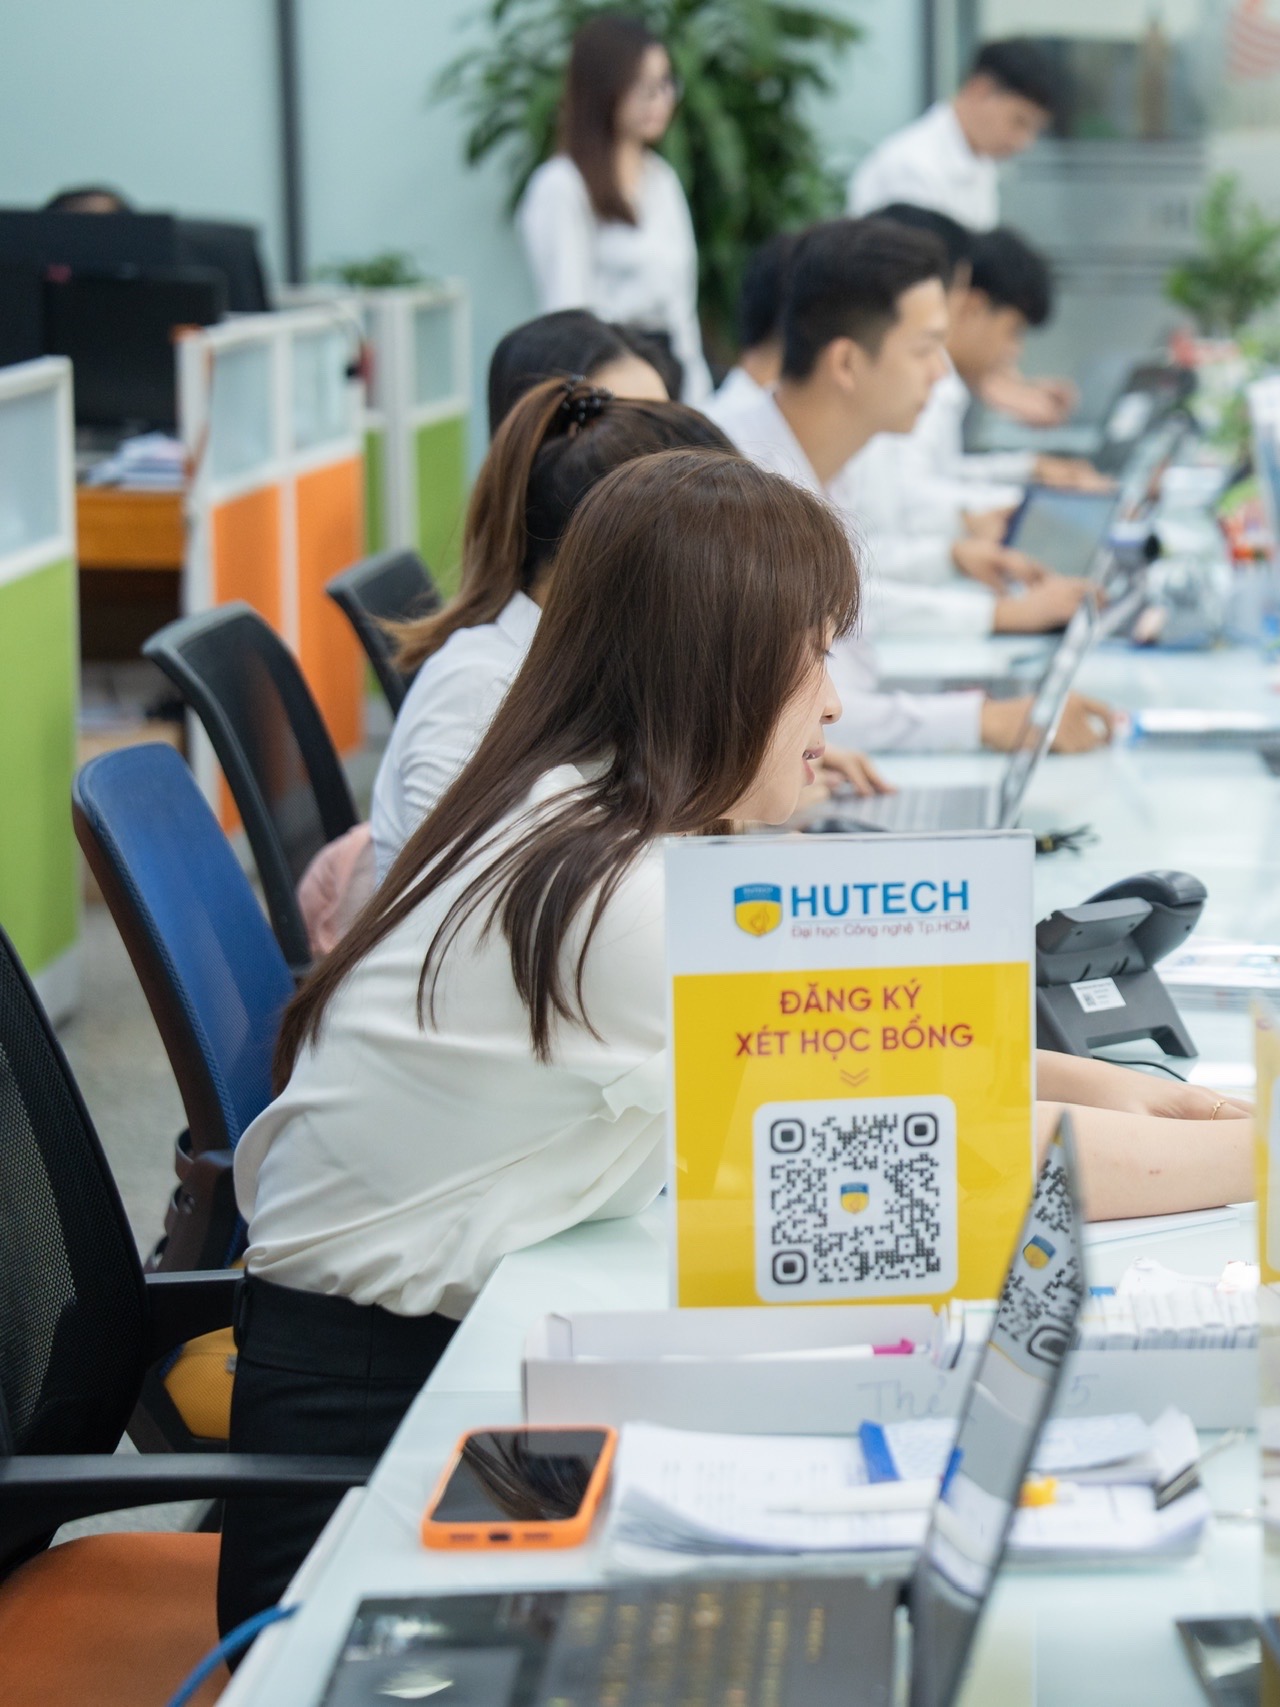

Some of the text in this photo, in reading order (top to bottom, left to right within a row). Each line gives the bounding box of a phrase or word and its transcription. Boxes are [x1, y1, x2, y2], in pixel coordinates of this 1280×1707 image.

[791, 879, 969, 917] HUTECH
[791, 919, 970, 938] Đại học Công nghệ Tp.HCM
[779, 978, 921, 1015] ĐĂNG KÝ
[736, 1014, 973, 1061] XÉT HỌC BỔNG
